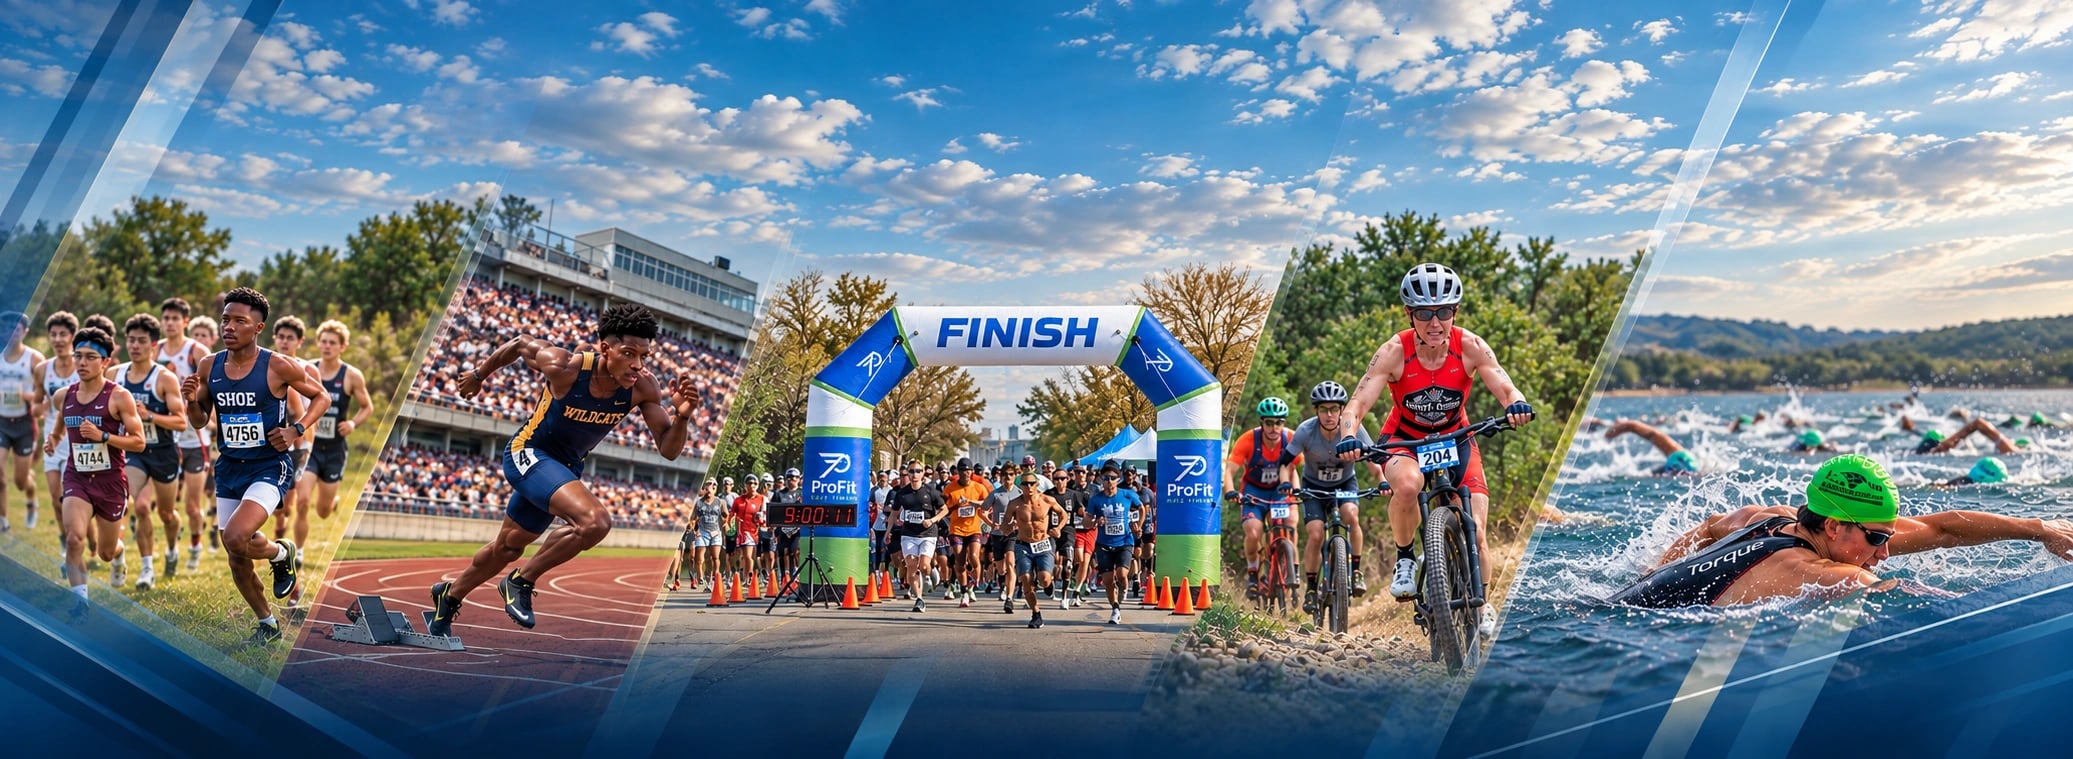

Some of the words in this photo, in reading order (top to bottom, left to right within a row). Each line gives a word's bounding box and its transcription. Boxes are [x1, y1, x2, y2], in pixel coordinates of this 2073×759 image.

[936, 317, 1099, 348] FINISH
[216, 392, 256, 407] SHOE
[563, 405, 625, 425] WILDCATS
[226, 425, 259, 442] 4756
[77, 451, 104, 465] 4744
[1423, 448, 1452, 466] 204
[811, 480, 857, 494] ProFit
[1167, 483, 1214, 497] ProFit
[784, 507, 853, 524] 9:00:11
[1687, 539, 1765, 577] Torque
